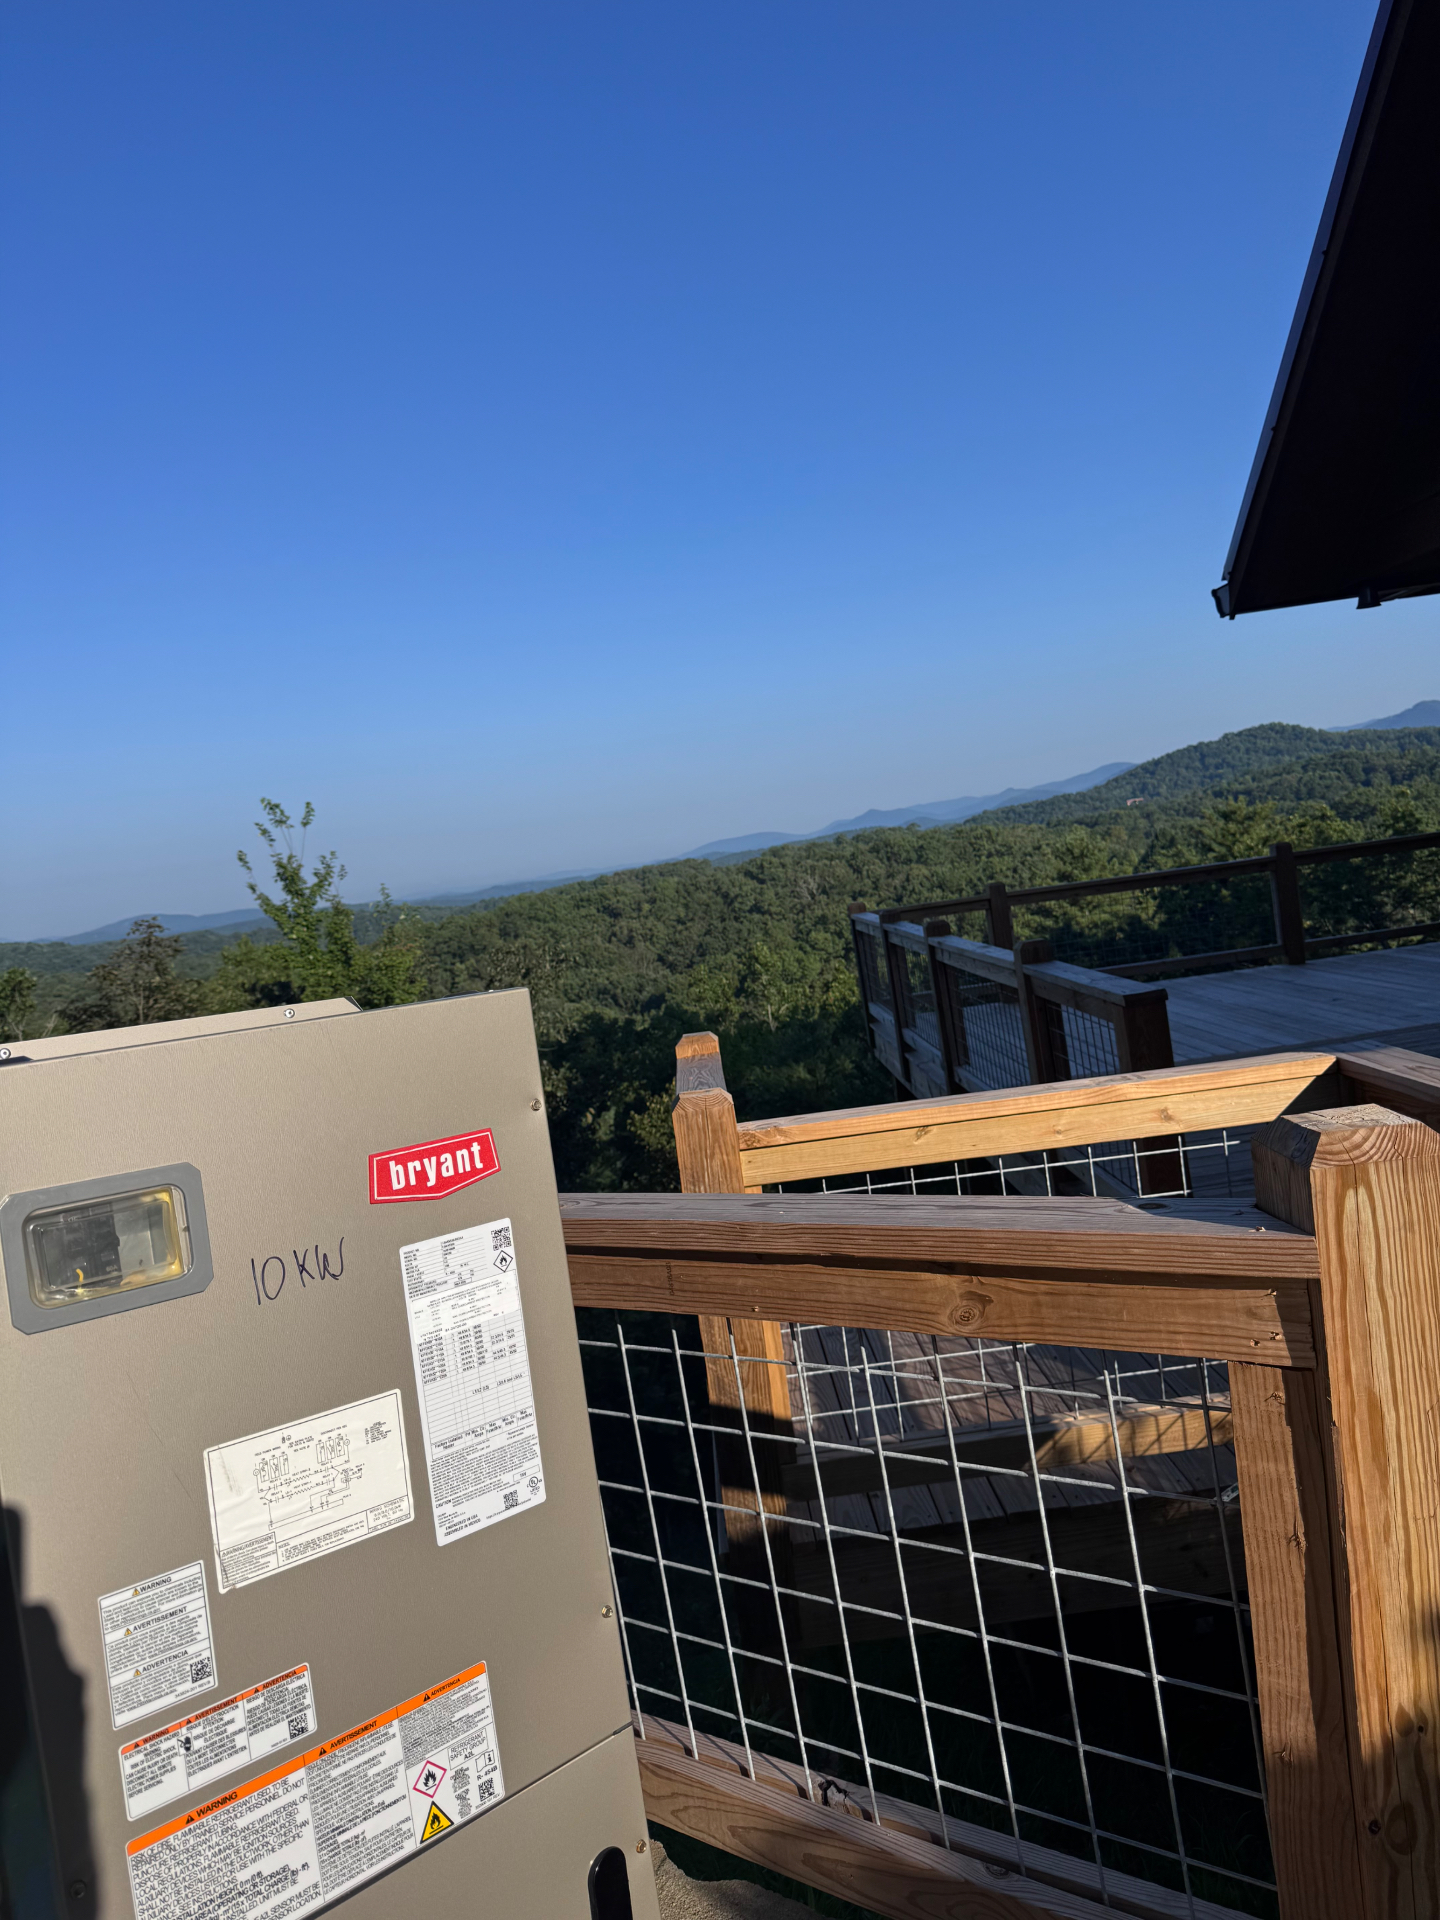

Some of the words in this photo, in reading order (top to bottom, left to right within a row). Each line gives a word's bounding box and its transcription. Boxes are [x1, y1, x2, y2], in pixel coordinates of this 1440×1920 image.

[389, 1142, 484, 1190] bryant
[250, 1256, 286, 1306] 10
[139, 1576, 171, 1593] WARNING
[132, 1605, 187, 1631] AVERTISSEMENT
[141, 1649, 188, 1672] ADVERTENCIA
[261, 1668, 297, 1690] ADVERTENCIA
[430, 1677, 460, 1697] ADVERTENCIA
[194, 1696, 235, 1721] AVERTISSEMENT
[142, 1727, 169, 1745] WARNING
[207, 1726, 213, 1734] DE
[217, 1735, 225, 1743] DES
[329, 1720, 377, 1749] AVERTISSEMENT
[450, 1731, 484, 1754] REFRIGERANT
[123, 1744, 148, 1761] ELECTRICAL
[148, 1738, 163, 1749] SHOCK
[163, 1730, 180, 1743] HAZARD
[139, 1758, 144, 1766] OF
[145, 1750, 162, 1763] ELECTRIC
[450, 1746, 468, 1761] SAFETY
[468, 1736, 486, 1751] GROUP
[463, 1749, 474, 1761] A2L
[125, 1771, 134, 1780] CAN
[133, 1765, 146, 1776] CAUSE
[146, 1759, 159, 1770] INJURY
[127, 1779, 145, 1792] ELECTRIC
[145, 1772, 158, 1784] POWER
[158, 1764, 176, 1777] SUPPLIES
[149, 1767, 157, 1775] ALL
[483, 1764, 497, 1777] 454B
[196, 1791, 237, 1819] WARNING
[130, 1851, 145, 1866] RISK
[145, 1845, 157, 1858] OF
[172, 1817, 211, 1844] FLAMMABLE
[210, 1795, 254, 1824] REFRIGERANT
[271, 1780, 281, 1792] TO
[280, 1776, 289, 1787] BE
[131, 1851, 165, 1874] REPAIRED
[164, 1842, 182, 1857] ONLY
[181, 1837, 191, 1848] BY
[191, 1822, 218, 1843] TRAINED
[218, 1809, 245, 1829] SERVICE
[282, 1784, 292, 1795] DO
[292, 1777, 305, 1790] NOT
[133, 1870, 163, 1892] DISPOSE
[163, 1864, 174, 1876] OF
[173, 1846, 208, 1870] PROPERLY
[207, 1842, 214, 1852] IN
[214, 1820, 257, 1849] ACCORDANCE
[256, 1812, 272, 1826] WITH
[272, 1798, 298, 1818] FEDERAL
[298, 1793, 309, 1804] OR
[132, 1857, 169, 1883] PUNCTURE
[169, 1833, 215, 1864] REFRIGERANT
[135, 1882, 157, 1900] LOCAL
[203, 1838, 240, 1864] FLAMMABLE
[239, 1815, 282, 1844] REFRIGERANT
[136, 1884, 170, 1908] AUXILIARY
[169, 1869, 198, 1891] DEVICES
[197, 1858, 220, 1876] WHICH
[219, 1851, 233, 1864] MAY
[232, 1846, 242, 1857] BE
[241, 1832, 268, 1852] IGNITION
[267, 1816, 297, 1838] SOURCES
[138, 1899, 160, 1917] SHALL
[159, 1891, 174, 1906] NOT
[173, 1887, 183, 1898] BE
[183, 1868, 217, 1893] INSTALLED
[216, 1865, 223, 1875] IN
[222, 1858, 236, 1872] THE
[272, 1827, 294, 1844] OTHER
[294, 1818, 310, 1833] THAN
[172, 1886, 200, 1908] DEVICES
[200, 1875, 222, 1892] LISTED
[222, 1867, 236, 1881] FOR
[235, 1860, 249, 1873] USE
[249, 1851, 265, 1866] WITH
[264, 1844, 277, 1858] THE
[276, 1830, 304, 1851] SPECIFIC
[244, 1887, 264, 1905] TOTAL
[263, 1872, 290, 1894] CHARGE
[248, 1881, 259, 1894] OR
[258, 1891, 273, 1905] UNIT
[272, 1882, 290, 1897] MUST
[290, 1877, 299, 1887] BE
[270, 1895, 295, 1915] SENSOR
[295, 1885, 312, 1901] MUST
[311, 1881, 320, 1892] BE
[178, 1900, 192, 1913] SEE
